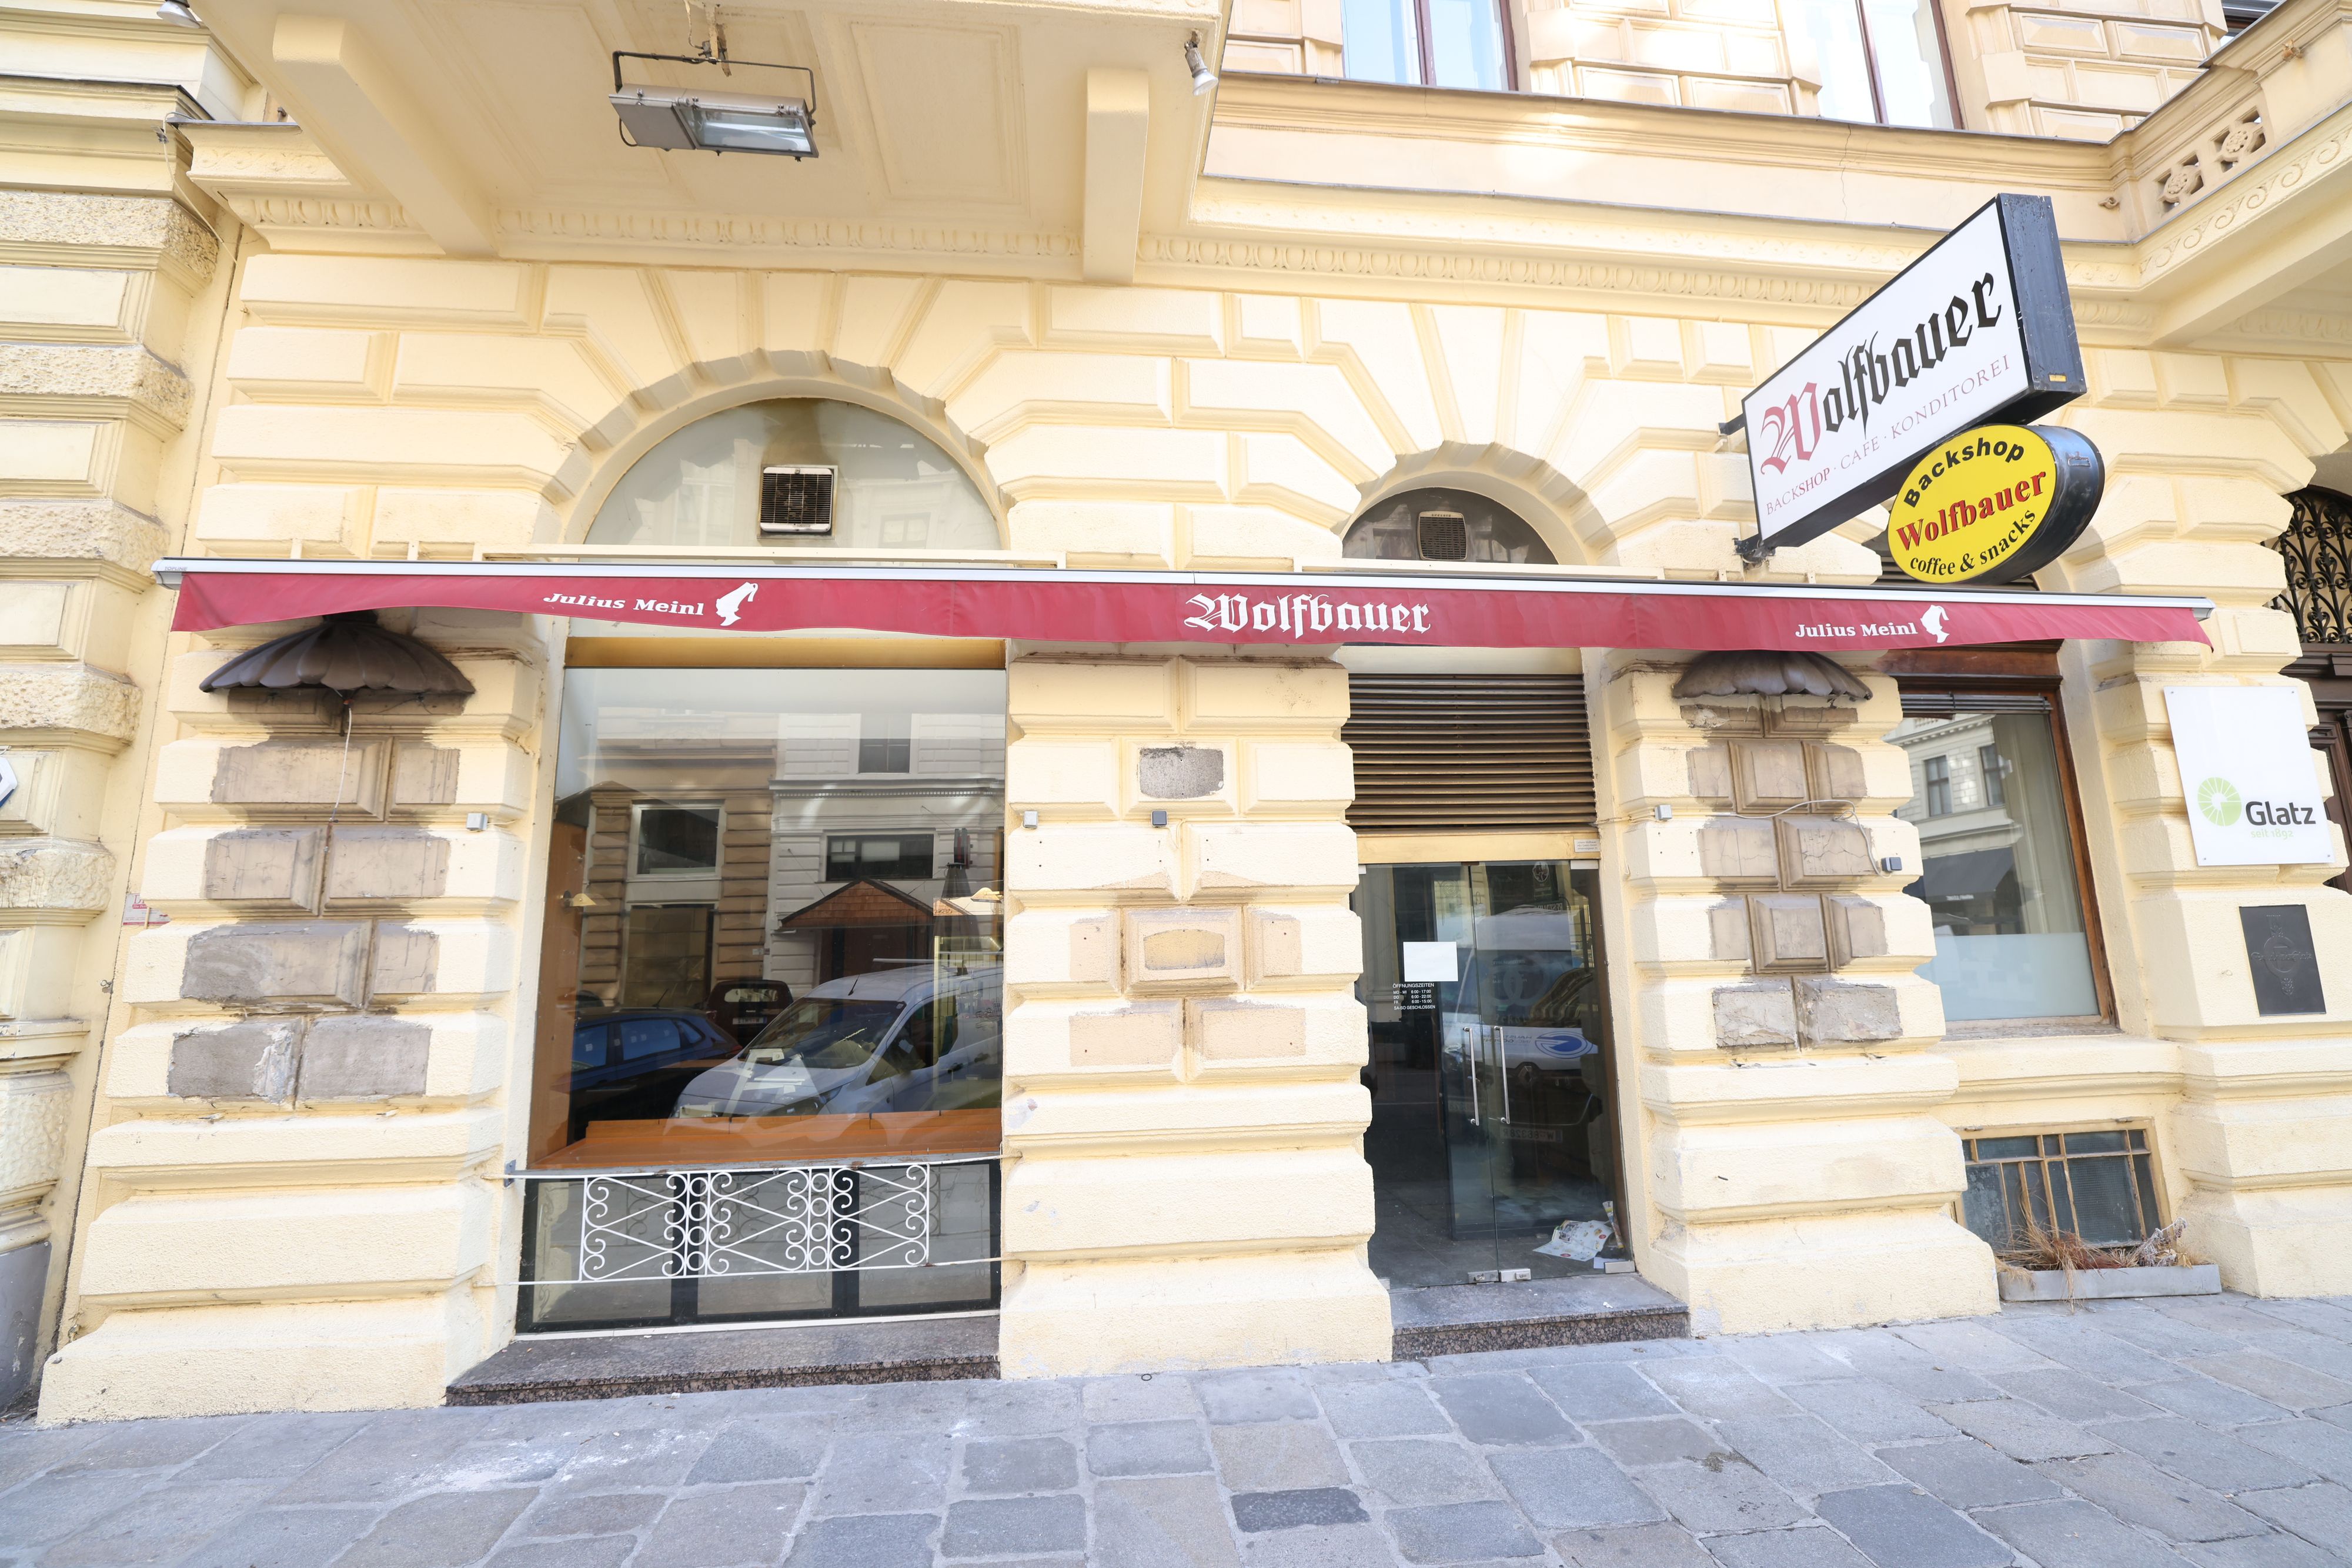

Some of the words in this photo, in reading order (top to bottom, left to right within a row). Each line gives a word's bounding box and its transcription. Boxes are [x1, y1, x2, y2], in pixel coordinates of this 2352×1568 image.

[1760, 272, 2002, 474] Wolfbauer
[1766, 467, 1830, 515] BACKSHOP
[1840, 436, 1880, 469] CAFE
[1891, 355, 2010, 439] KONDITOREI
[1903, 437, 2024, 508] Backshop
[1896, 472, 2046, 551] Wolfbauer
[1910, 557, 1955, 576] coffee
[1960, 553, 1975, 572] &
[1980, 510, 2036, 564] snacks
[543, 593, 626, 609] Julius
[633, 599, 704, 616] Meinl
[1184, 593, 1431, 639] Wolfbauer
[1795, 623, 1856, 637] Julius
[1860, 622, 1918, 637] Meinl
[2246, 801, 2316, 825] Glatz
[2251, 828, 2269, 838] seit
[2271, 828, 2294, 840] 1892
